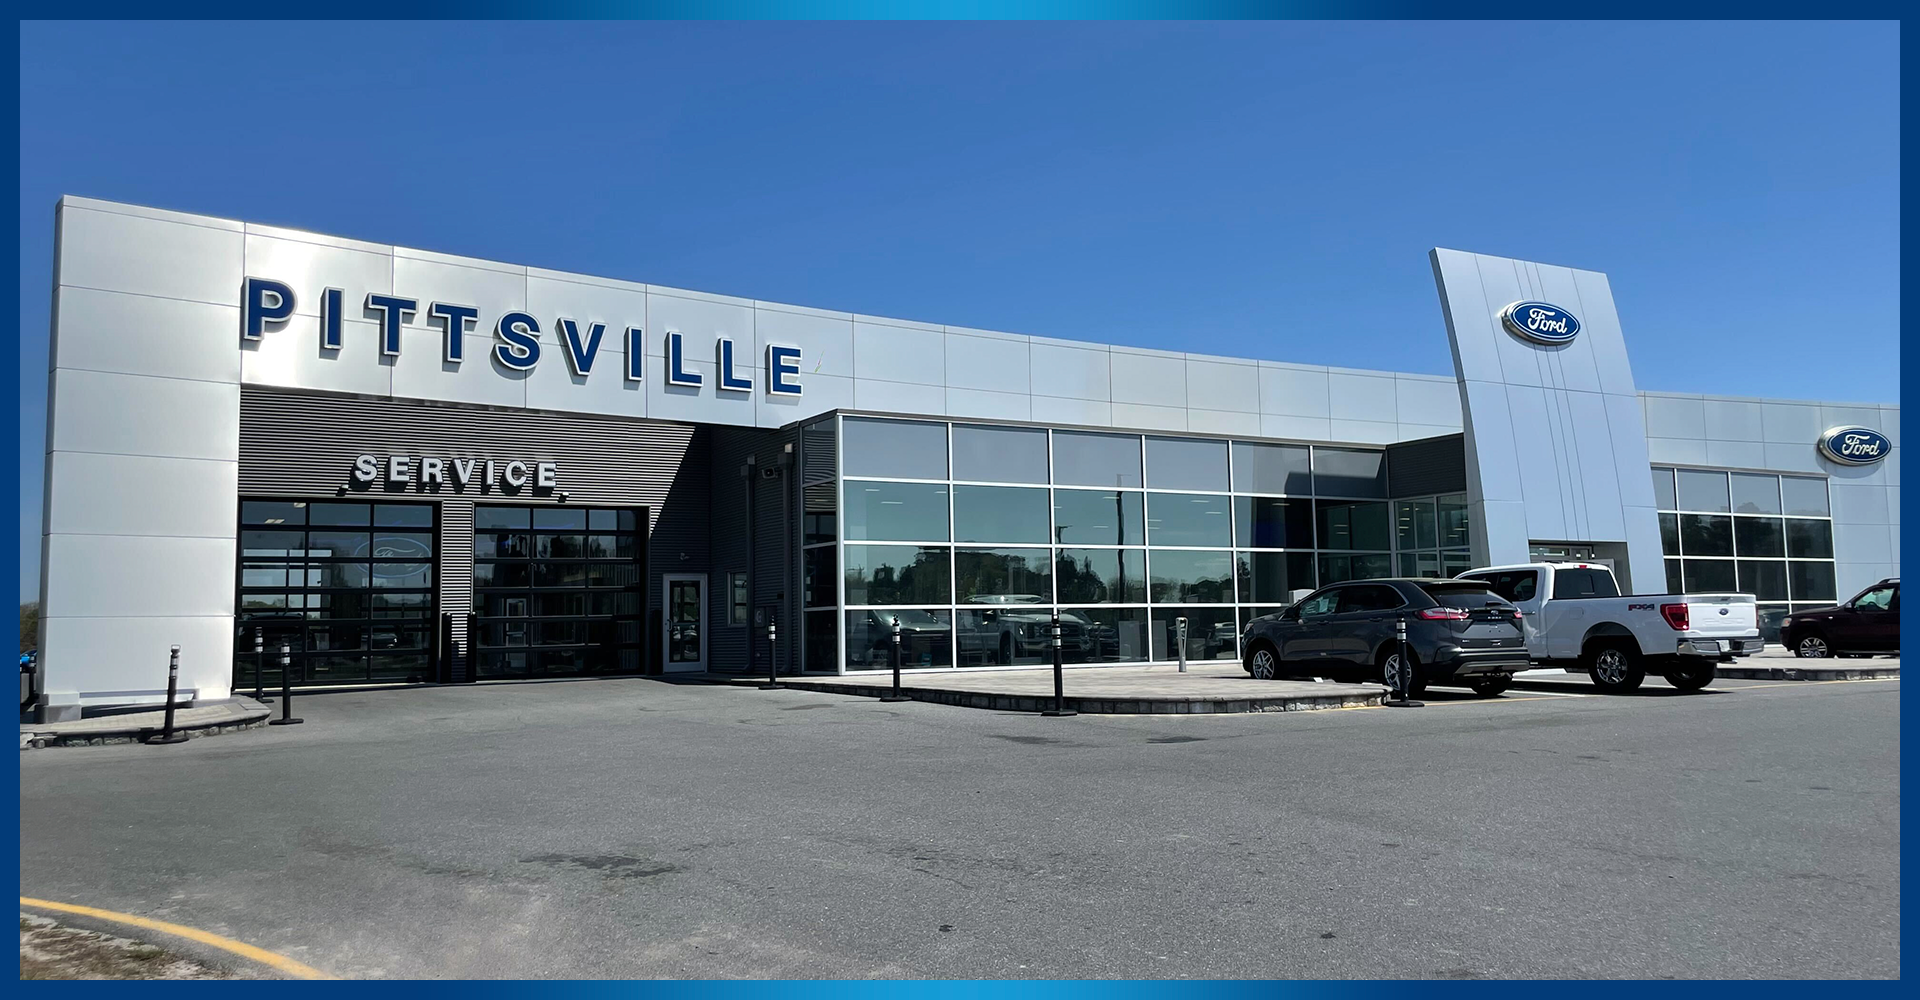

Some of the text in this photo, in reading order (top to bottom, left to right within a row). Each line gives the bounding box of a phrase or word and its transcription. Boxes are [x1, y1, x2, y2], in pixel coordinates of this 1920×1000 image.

[1527, 308, 1568, 334] Ford
[243, 275, 803, 396] PITTSVILLE
[1841, 434, 1880, 456] Ford
[354, 454, 557, 487] SERVICE
[1628, 603, 1655, 612] FX4
